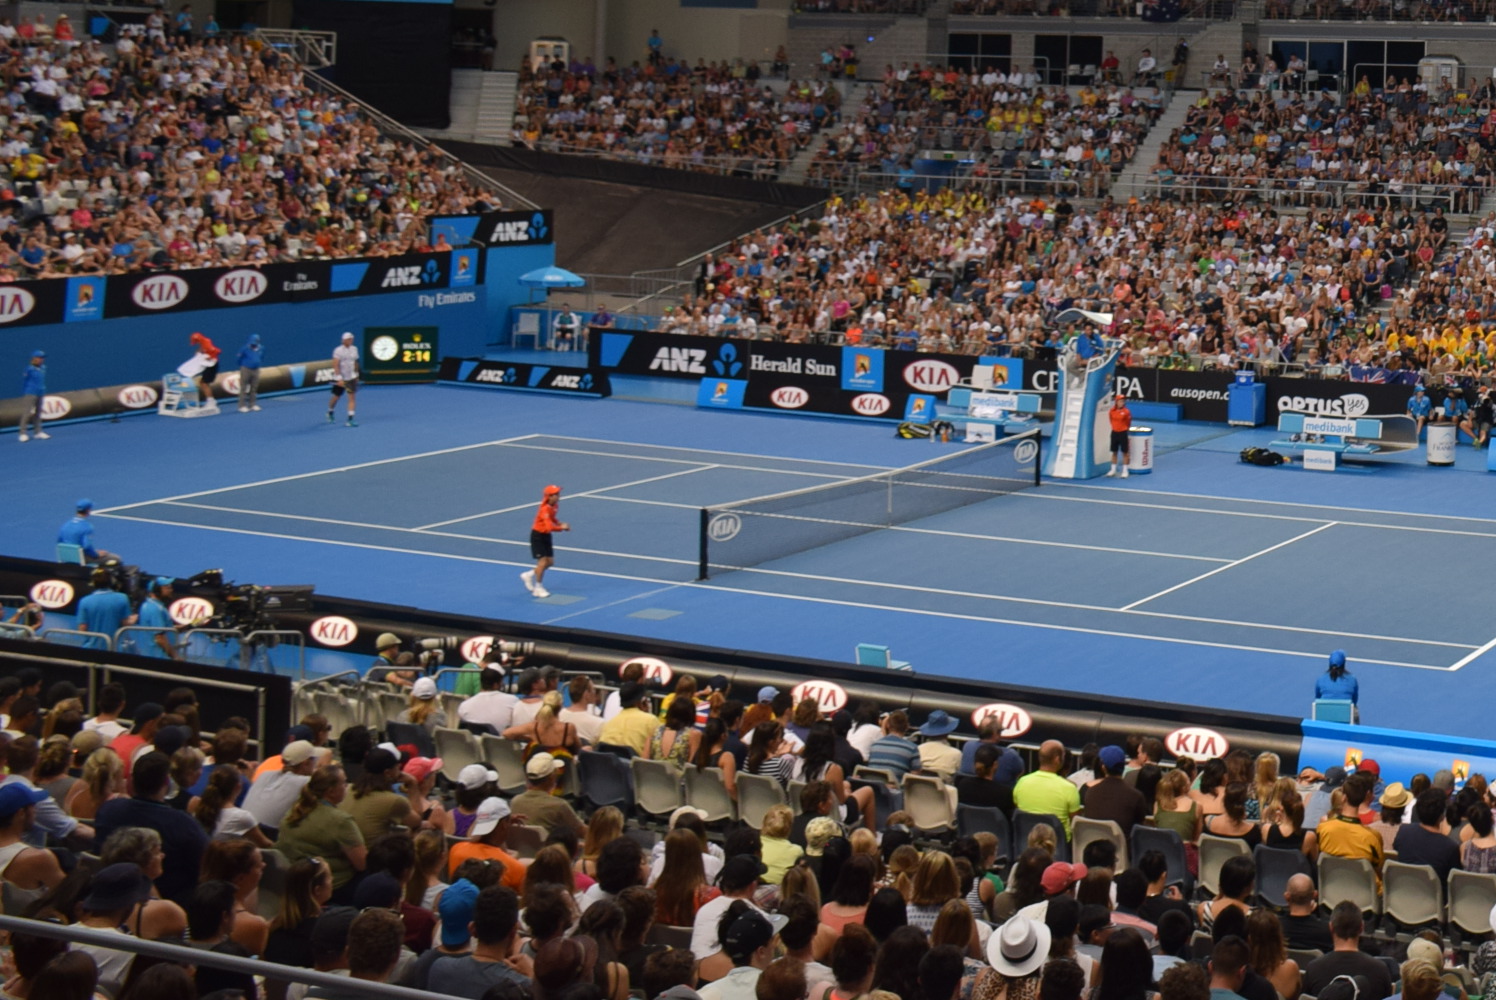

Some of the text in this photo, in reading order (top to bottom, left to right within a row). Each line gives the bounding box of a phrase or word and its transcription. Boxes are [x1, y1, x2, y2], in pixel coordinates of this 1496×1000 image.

[490, 221, 529, 242] ANZ
[223, 275, 260, 296] KIA
[381, 266, 422, 287] ANZ
[141, 282, 182, 304] KIA
[283, 281, 318, 291] Emirates
[0, 294, 25, 315] IA
[418, 291, 476, 308] Fly Emirates
[403, 350, 430, 362] 2:14
[650, 346, 707, 375] ANZ
[750, 354, 836, 377] Herald Sun
[476, 369, 504, 383] ANZ
[551, 374, 579, 389] ANZ
[913, 366, 950, 386] KIA
[1032, 371, 1059, 391] CP
[125, 390, 153, 403] KIA
[778, 390, 802, 405] KIA
[1171, 387, 1230, 401] ausopen.c
[858, 397, 883, 411] KIA
[1278, 396, 1365, 415] OPTUS yes
[1306, 422, 1353, 434] medibank
[713, 518, 736, 537] KIA
[38, 585, 66, 603] KIA
[176, 603, 206, 619] KIA
[318, 622, 348, 640] KIA
[1176, 733, 1217, 756] KIA
